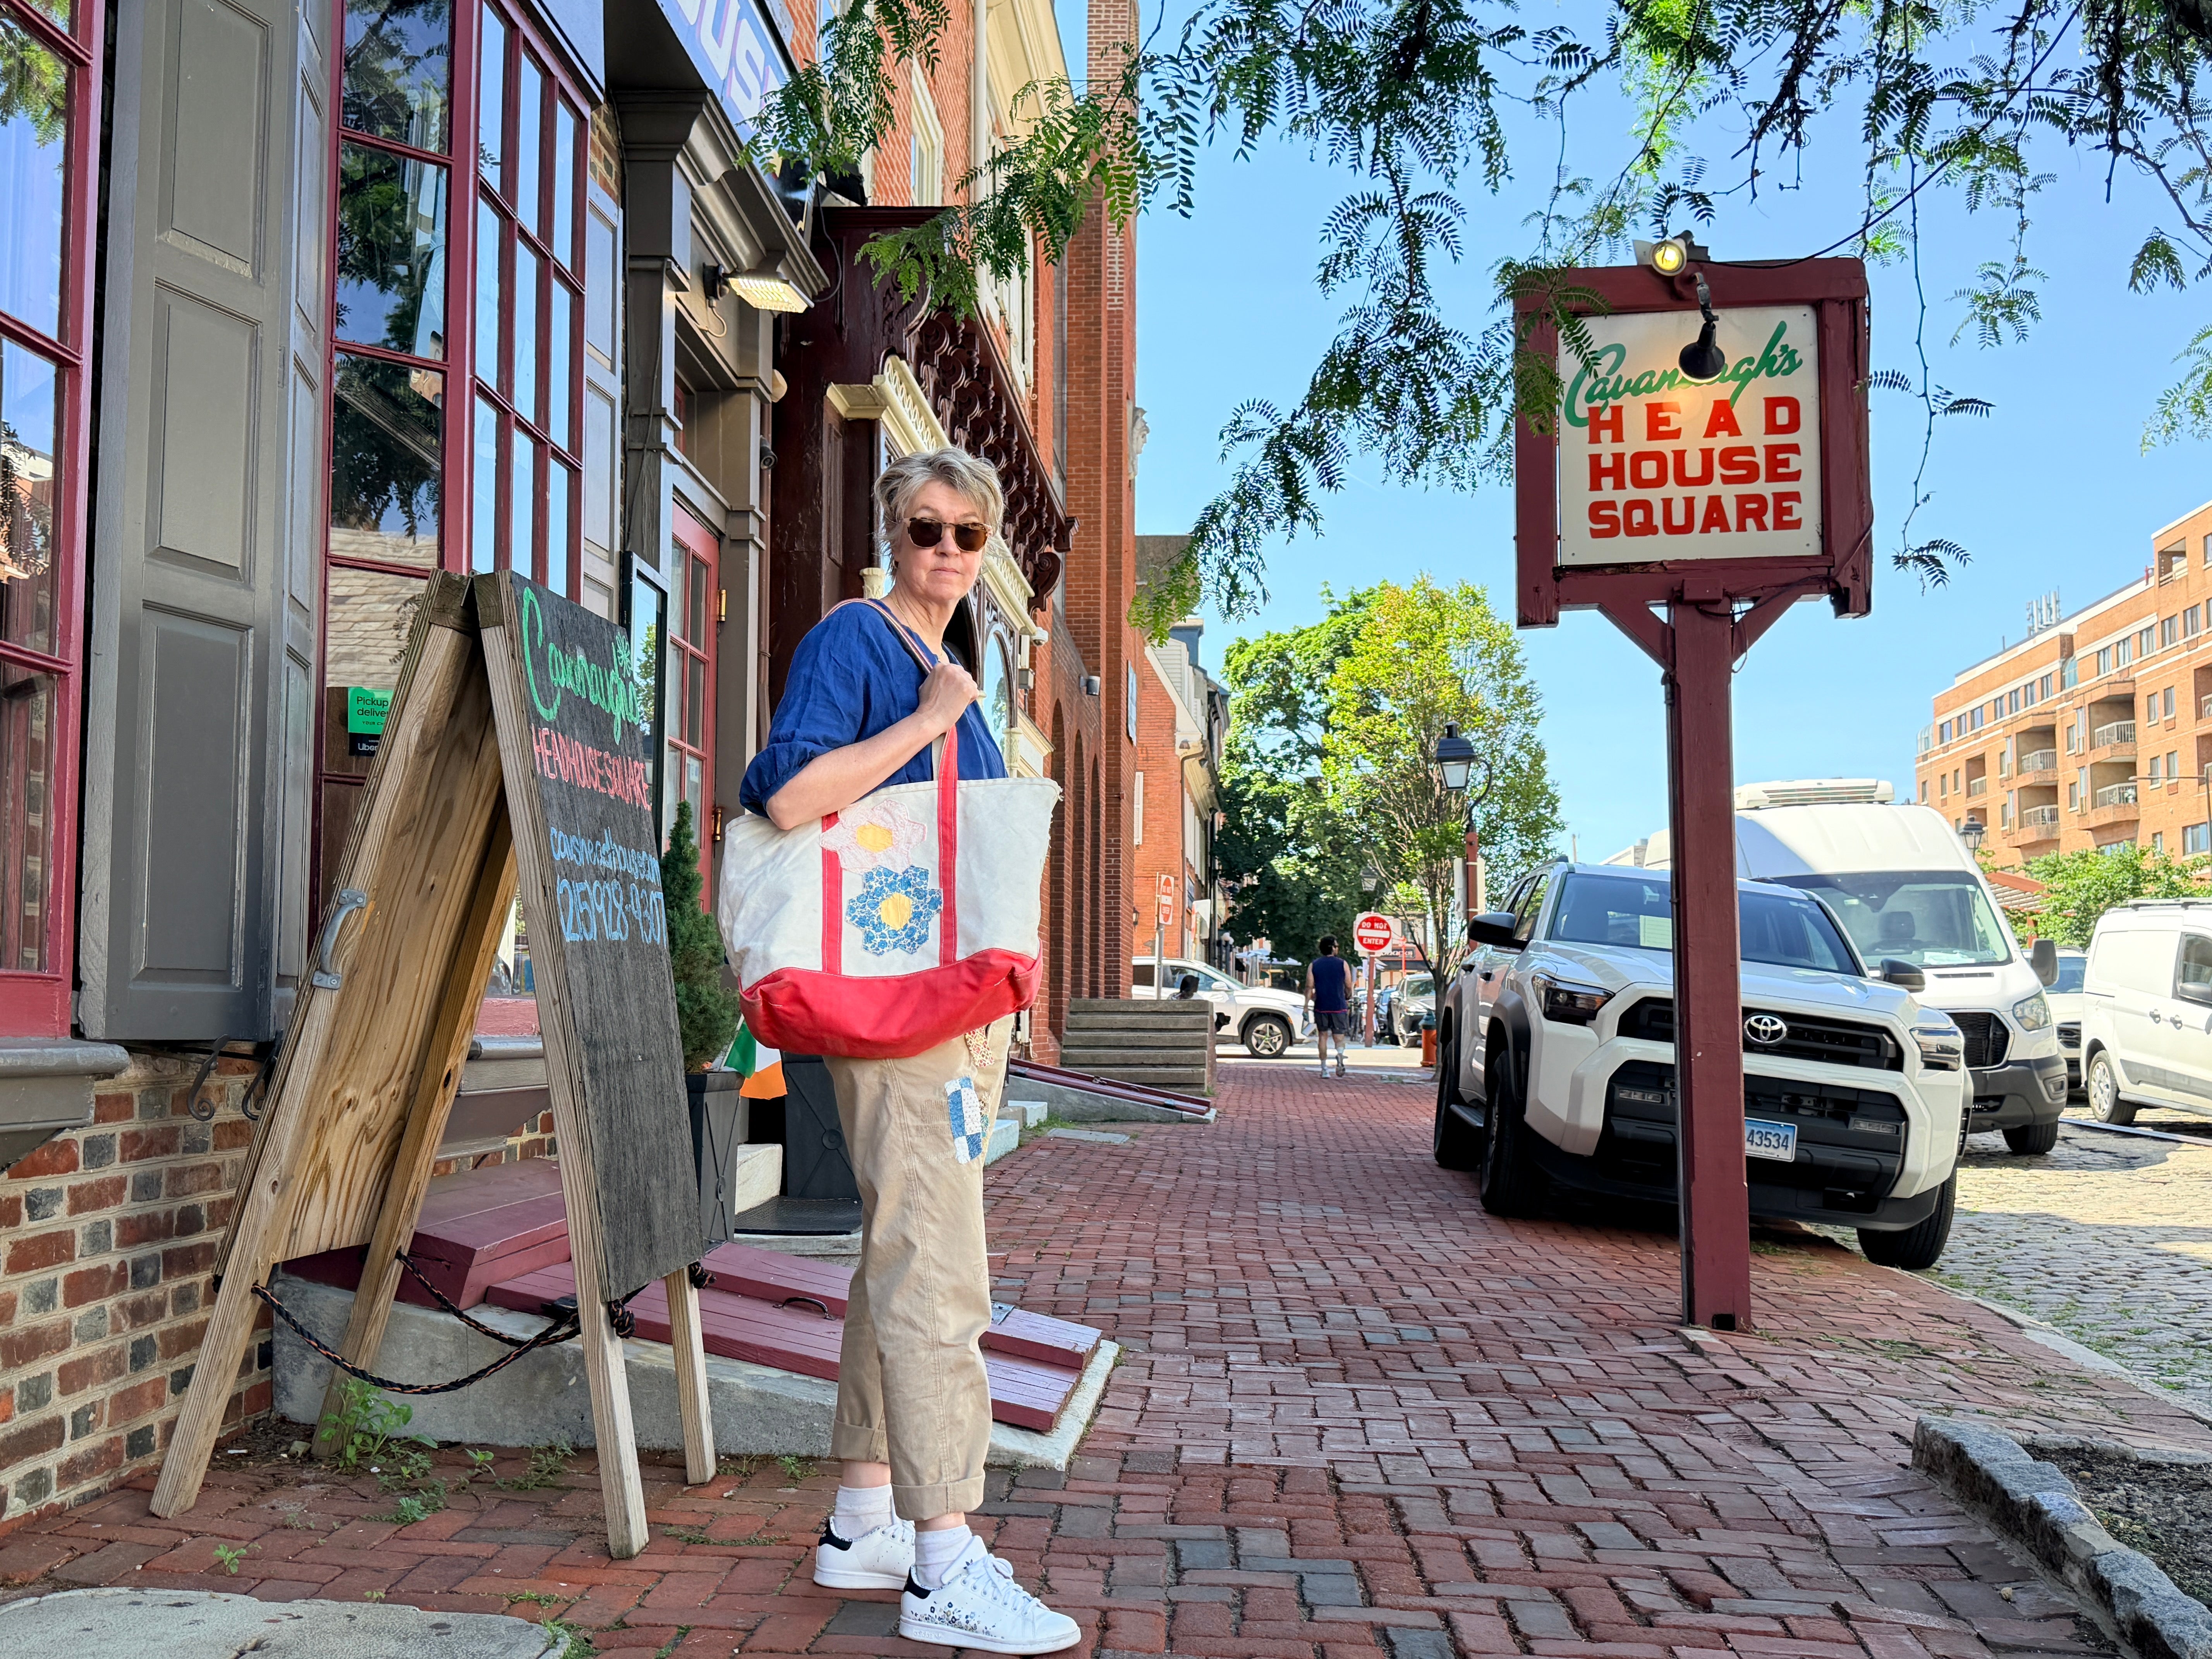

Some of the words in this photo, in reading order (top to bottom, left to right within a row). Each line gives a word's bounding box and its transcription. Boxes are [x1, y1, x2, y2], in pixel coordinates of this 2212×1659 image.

[1565, 321, 1803, 427] Cavanugh's
[1588, 396, 1801, 444] HEAD
[1588, 443, 1802, 491] HOUSE
[1588, 491, 1802, 539] SQUARE
[357, 696, 389, 708] Pickup
[358, 743, 378, 751] Uber
[604, 751, 652, 812] SQUARE
[1747, 1129, 1789, 1150] 43534
